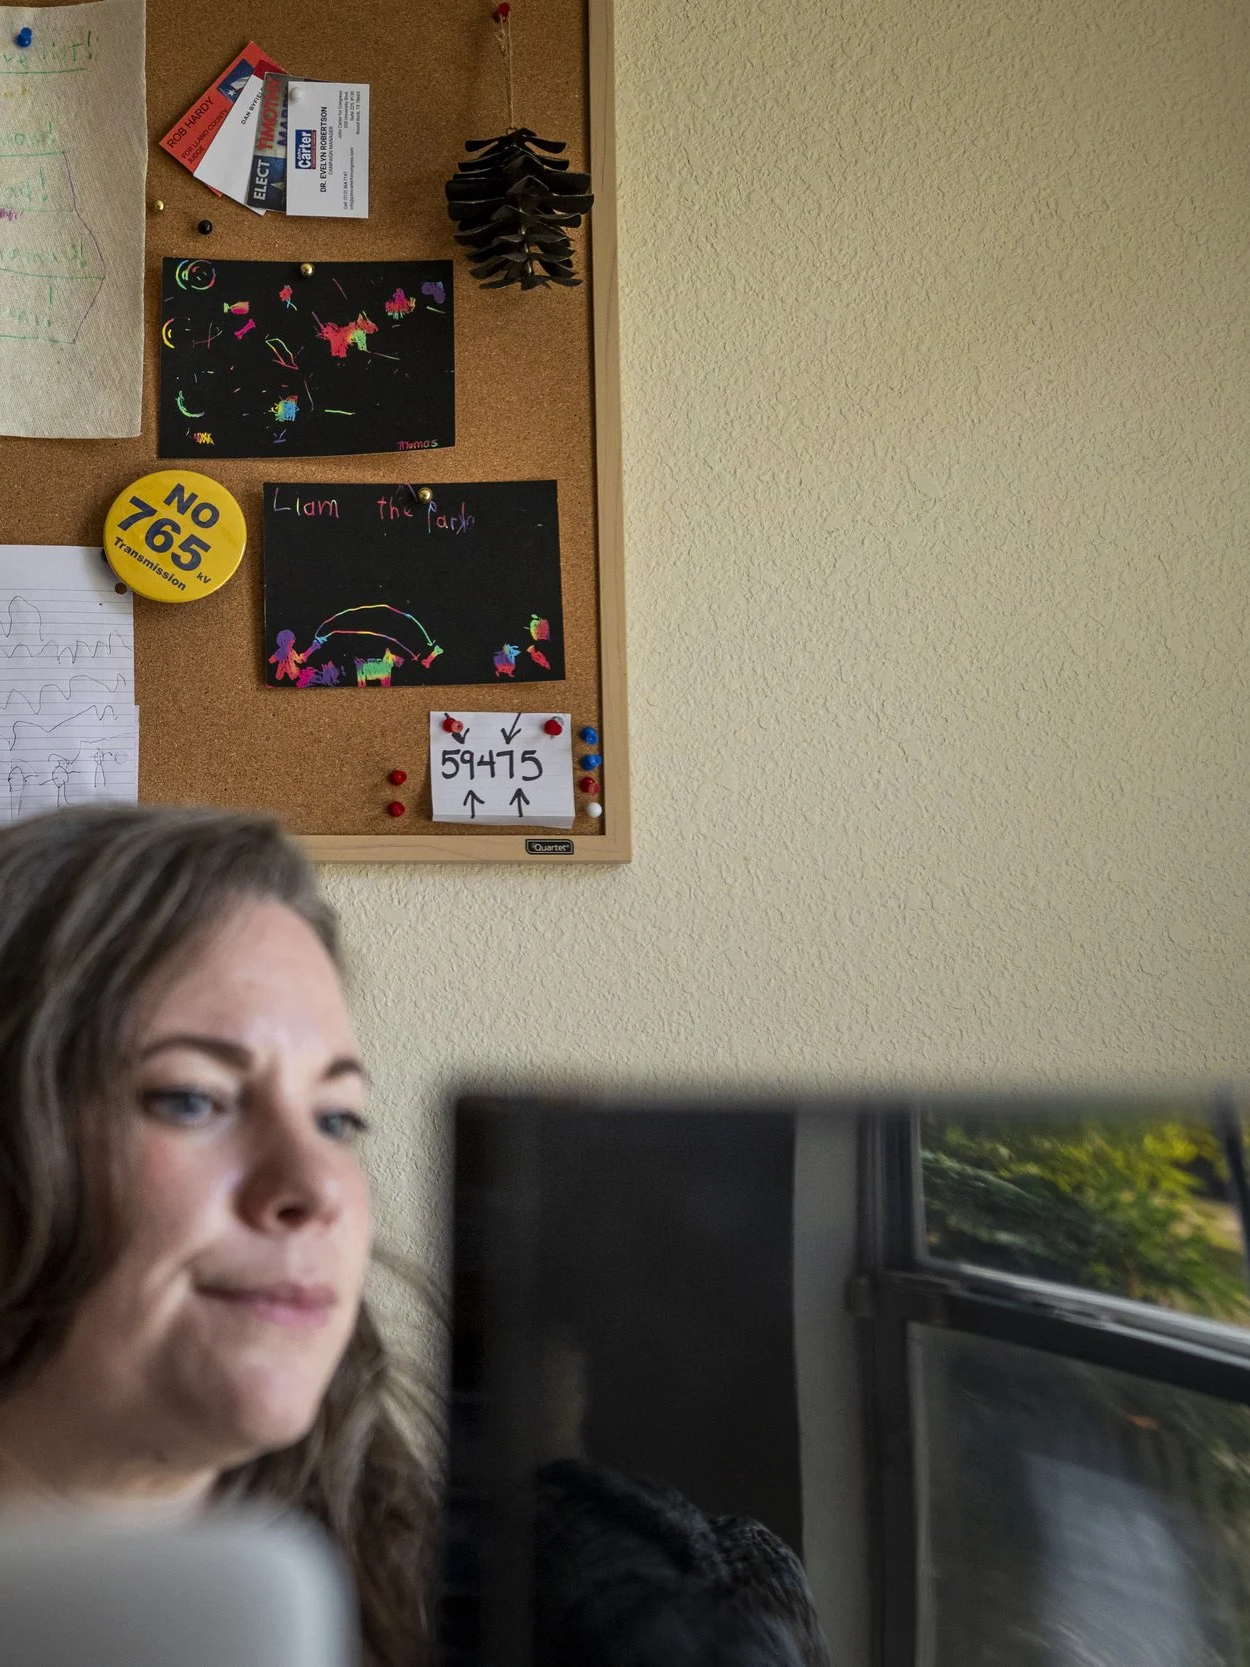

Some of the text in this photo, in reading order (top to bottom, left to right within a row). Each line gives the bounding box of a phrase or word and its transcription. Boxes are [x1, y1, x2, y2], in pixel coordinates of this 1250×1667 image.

[166, 96, 214, 149] ROB HARDY
[180, 108, 228, 159] FOR LLANO COUNTY
[240, 111, 251, 124] DAN
[257, 78, 282, 151] TIMOTHY
[187, 144, 205, 163] JUDGE
[298, 132, 311, 168] Carter
[254, 160, 270, 200] ELECT
[163, 483, 220, 529] NO
[273, 488, 339, 518] Liam
[377, 496, 413, 521] the
[117, 496, 212, 584] 765 kV
[114, 536, 186, 590] Transmission
[442, 750, 543, 781] 59475
